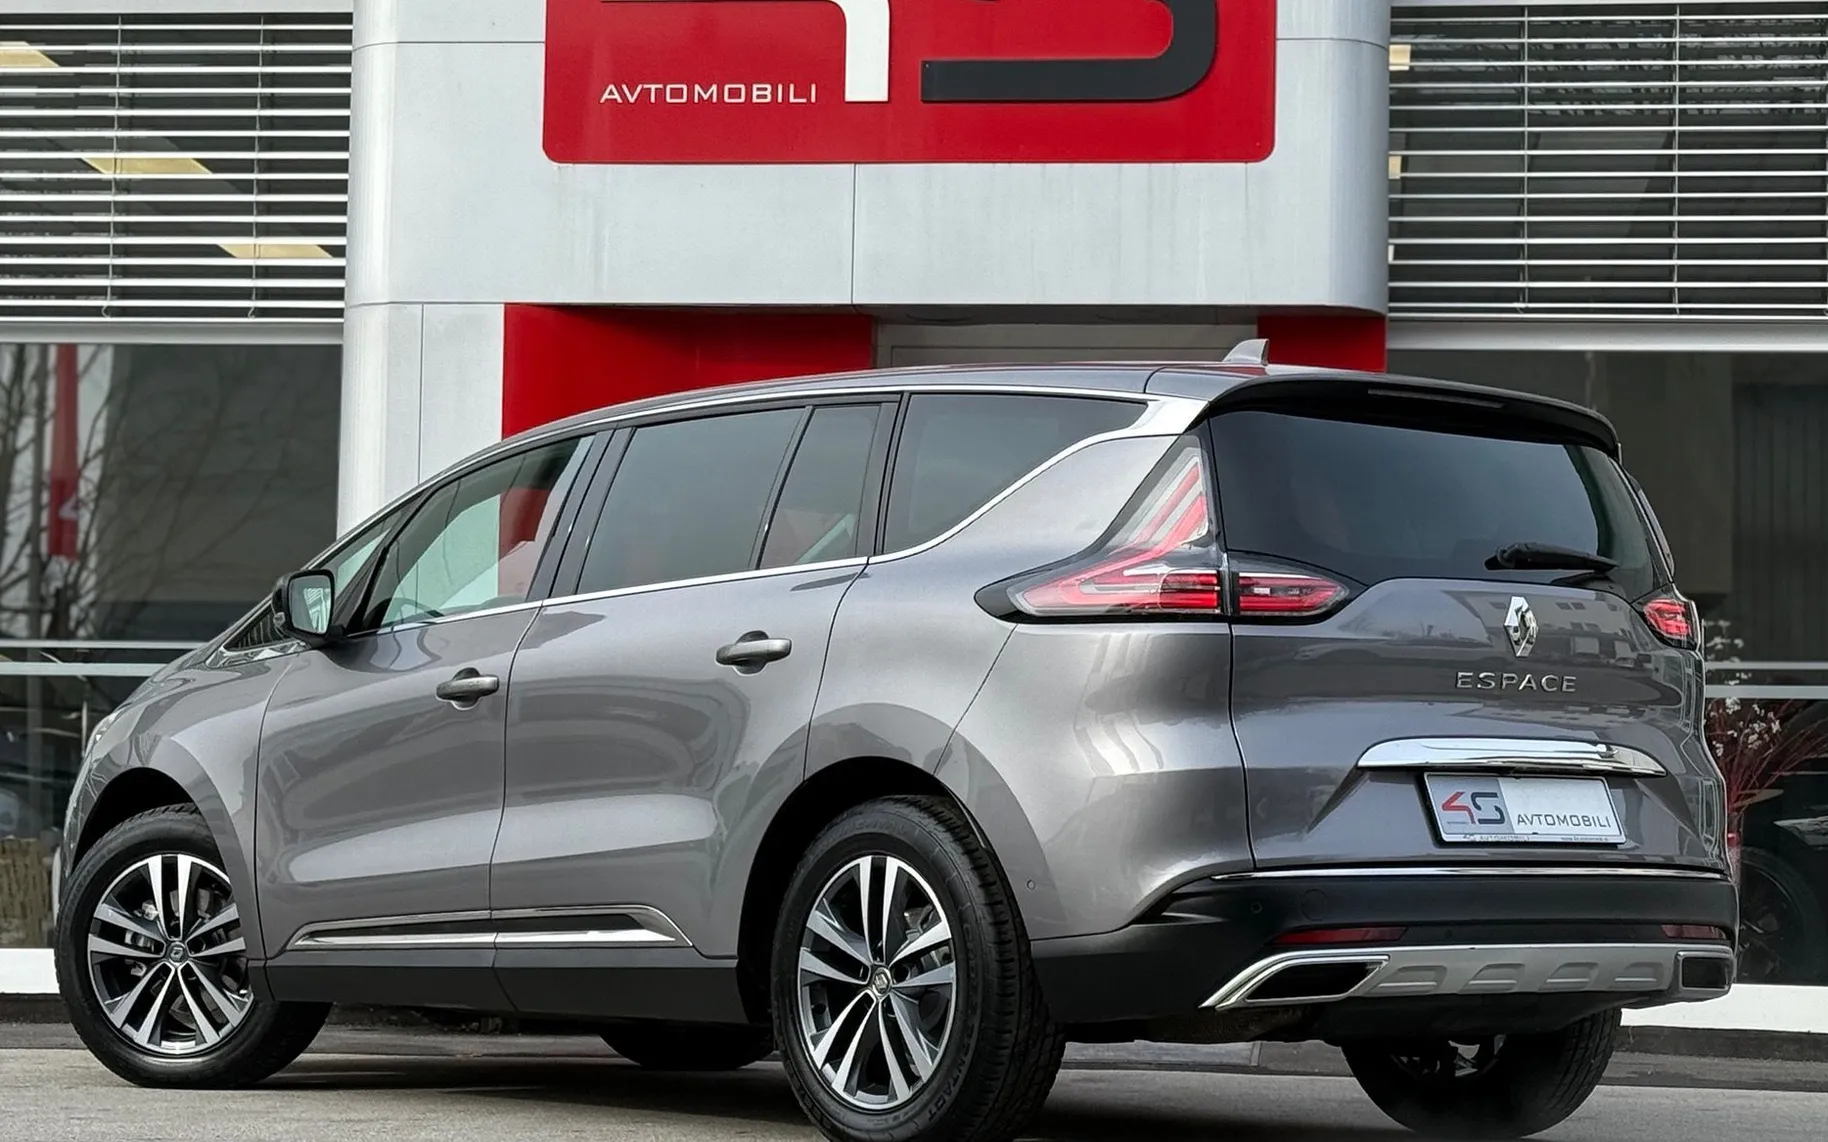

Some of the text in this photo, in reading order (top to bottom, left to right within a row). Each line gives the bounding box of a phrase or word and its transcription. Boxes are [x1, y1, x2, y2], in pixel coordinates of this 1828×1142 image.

[600, 83, 818, 103] AVTOMOBILI
[1455, 672, 1577, 692] ESPACE
[1442, 792, 1611, 828] 4S AVTOMOBILI
